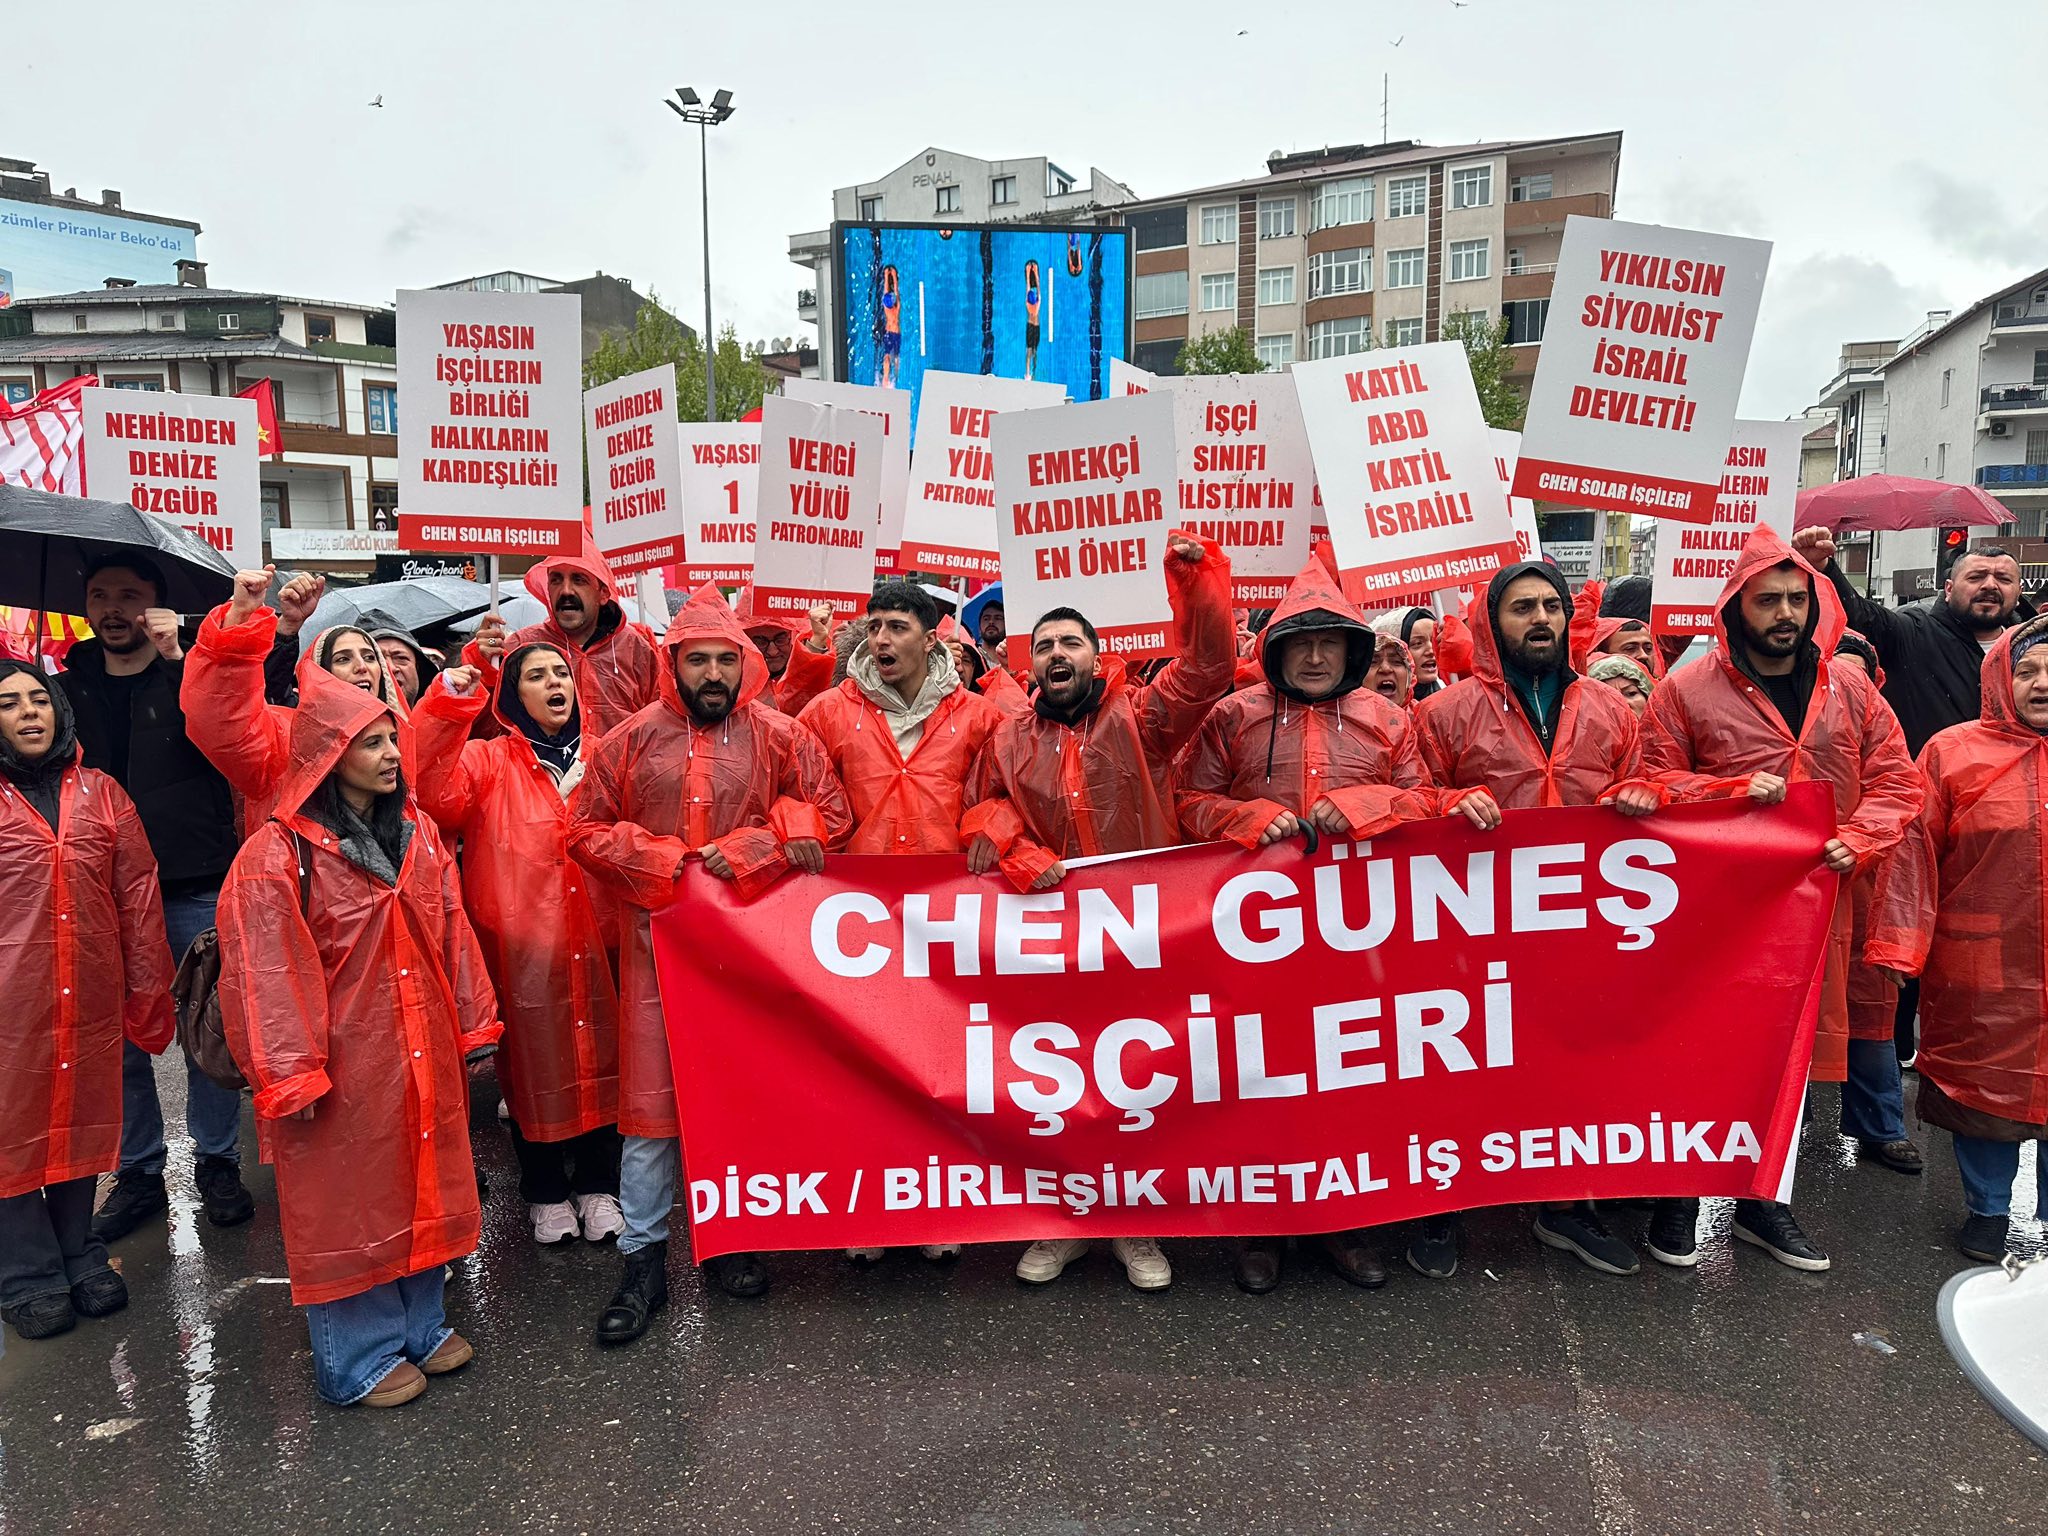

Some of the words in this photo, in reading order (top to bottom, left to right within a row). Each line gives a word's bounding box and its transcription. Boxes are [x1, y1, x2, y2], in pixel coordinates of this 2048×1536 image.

[912, 170, 952, 188] PENAH
[58, 221, 117, 241] Piranlar
[1600, 250, 1726, 297] YIKILSIN
[1581, 292, 1723, 343] SİYONİST
[442, 323, 534, 353] YAŞASIN
[436, 353, 542, 387] İŞÇİLERIN
[1593, 337, 1688, 386] İSRAİL
[1344, 359, 1428, 403] KATİL
[450, 388, 529, 418] BİRLİĞİ
[595, 387, 663, 430] NEHİRDEN
[1205, 400, 1258, 436] İŞÇİ
[1569, 385, 1697, 433] DEVLETİ!
[105, 411, 236, 446] NEHİRDEN
[431, 425, 549, 453] HALKLARIN
[607, 424, 654, 458] DENİZE
[1367, 408, 1429, 446] ABD
[129, 449, 217, 480] DENİZE
[422, 457, 558, 489] KARDEŞLİĞİ!
[609, 456, 656, 490] ÖZGÜR
[788, 436, 856, 478] VERGİ
[1027, 435, 1140, 486] EMEKÇİ
[1193, 444, 1266, 471] SINIFI
[1366, 447, 1451, 492] KATİL
[131, 482, 218, 516] ÖZGÜR
[605, 487, 666, 524] FİLİSTİN!
[723, 480, 739, 514] 1
[789, 480, 850, 521] YÜKÜ
[1538, 472, 1577, 493] CHEN
[1580, 479, 1628, 500] SOLAR
[1629, 483, 1692, 510] İŞÇİLERİ
[1012, 488, 1163, 536] KADINLAR
[1364, 490, 1474, 539] İSRAİL!
[421, 525, 457, 542] CHEN
[459, 527, 502, 544] SOLAR
[504, 526, 560, 547] İŞÇİLERİ
[701, 522, 757, 543] MAYIS
[770, 521, 863, 549] PATRONLARA!
[401, 560, 434, 581] Gloria
[623, 551, 644, 566] SOLAR
[645, 542, 674, 562] İŞÇİLERİ
[917, 551, 944, 566] CHEN
[945, 554, 978, 569] SOLAR
[1035, 546, 1072, 581] EN
[1078, 537, 1147, 577] ÖNE!
[688, 570, 712, 580] CHEN
[713, 570, 740, 580] SOLAR
[1365, 571, 1400, 590] CHEN
[1402, 563, 1445, 585] SOLAR
[1446, 554, 1501, 579] İŞÇİLERİ
[768, 596, 792, 609] CHEN
[1667, 613, 1693, 627] CHEN
[1110, 630, 1166, 654] İŞÇİLERİ
[810, 883, 1162, 979] CHEN
[1212, 838, 1680, 964] GÜNEŞ
[965, 961, 1514, 1136] İŞÇİLERİ
[690, 1165, 830, 1225] DİSK
[847, 1169, 864, 1214] /
[884, 1155, 1168, 1216] BİRLEŞİK
[1188, 1151, 1389, 1204] METAL
[1407, 1133, 1461, 1190] İŞ
[1481, 1110, 1762, 1173] SENDİKA
